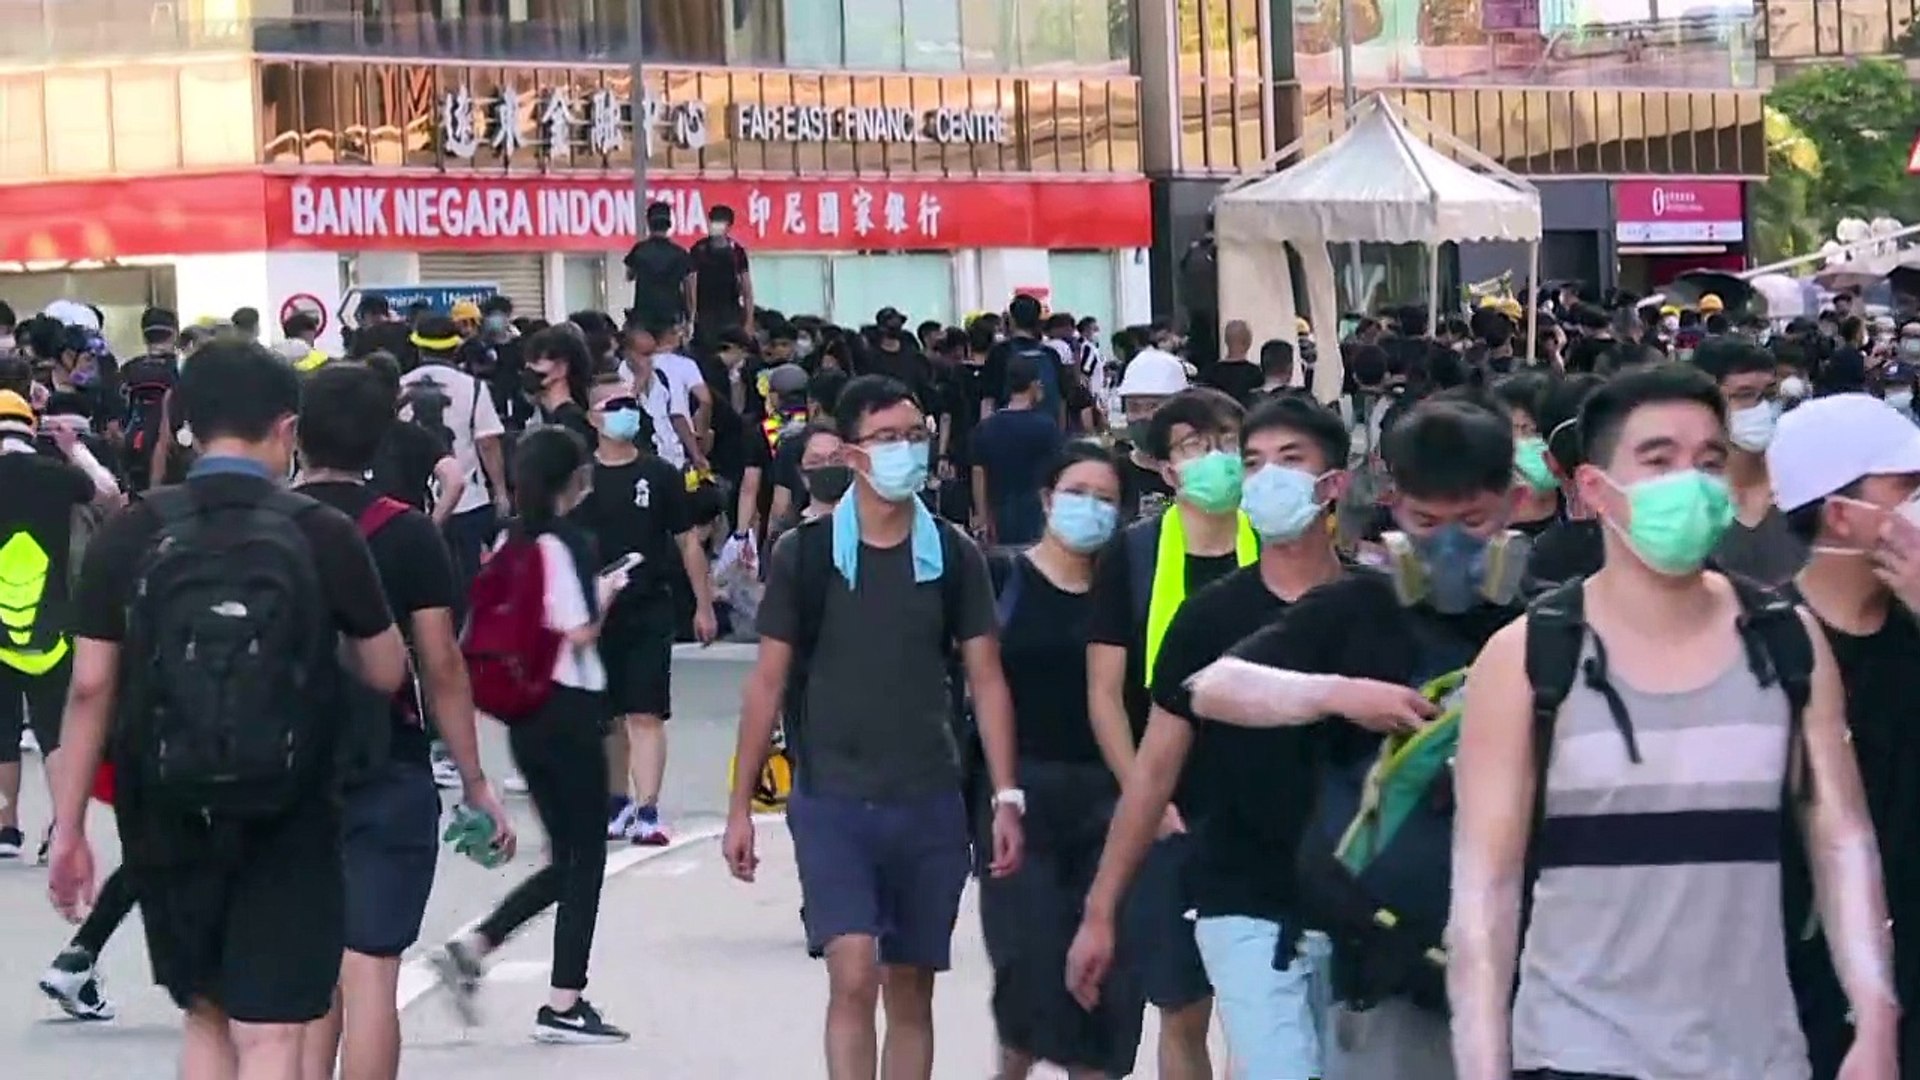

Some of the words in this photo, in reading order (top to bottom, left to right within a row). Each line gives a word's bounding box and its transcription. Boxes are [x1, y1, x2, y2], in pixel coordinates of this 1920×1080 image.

[738, 105, 780, 141] FAR
[783, 106, 836, 142] EAST
[845, 108, 931, 143] FINANCE
[935, 108, 1008, 144] CENTRE
[291, 185, 389, 237] BANK
[394, 186, 534, 237] NEGARA
[537, 188, 709, 238] INDONSIA
[748, 187, 942, 239] 印尼國家銀行
